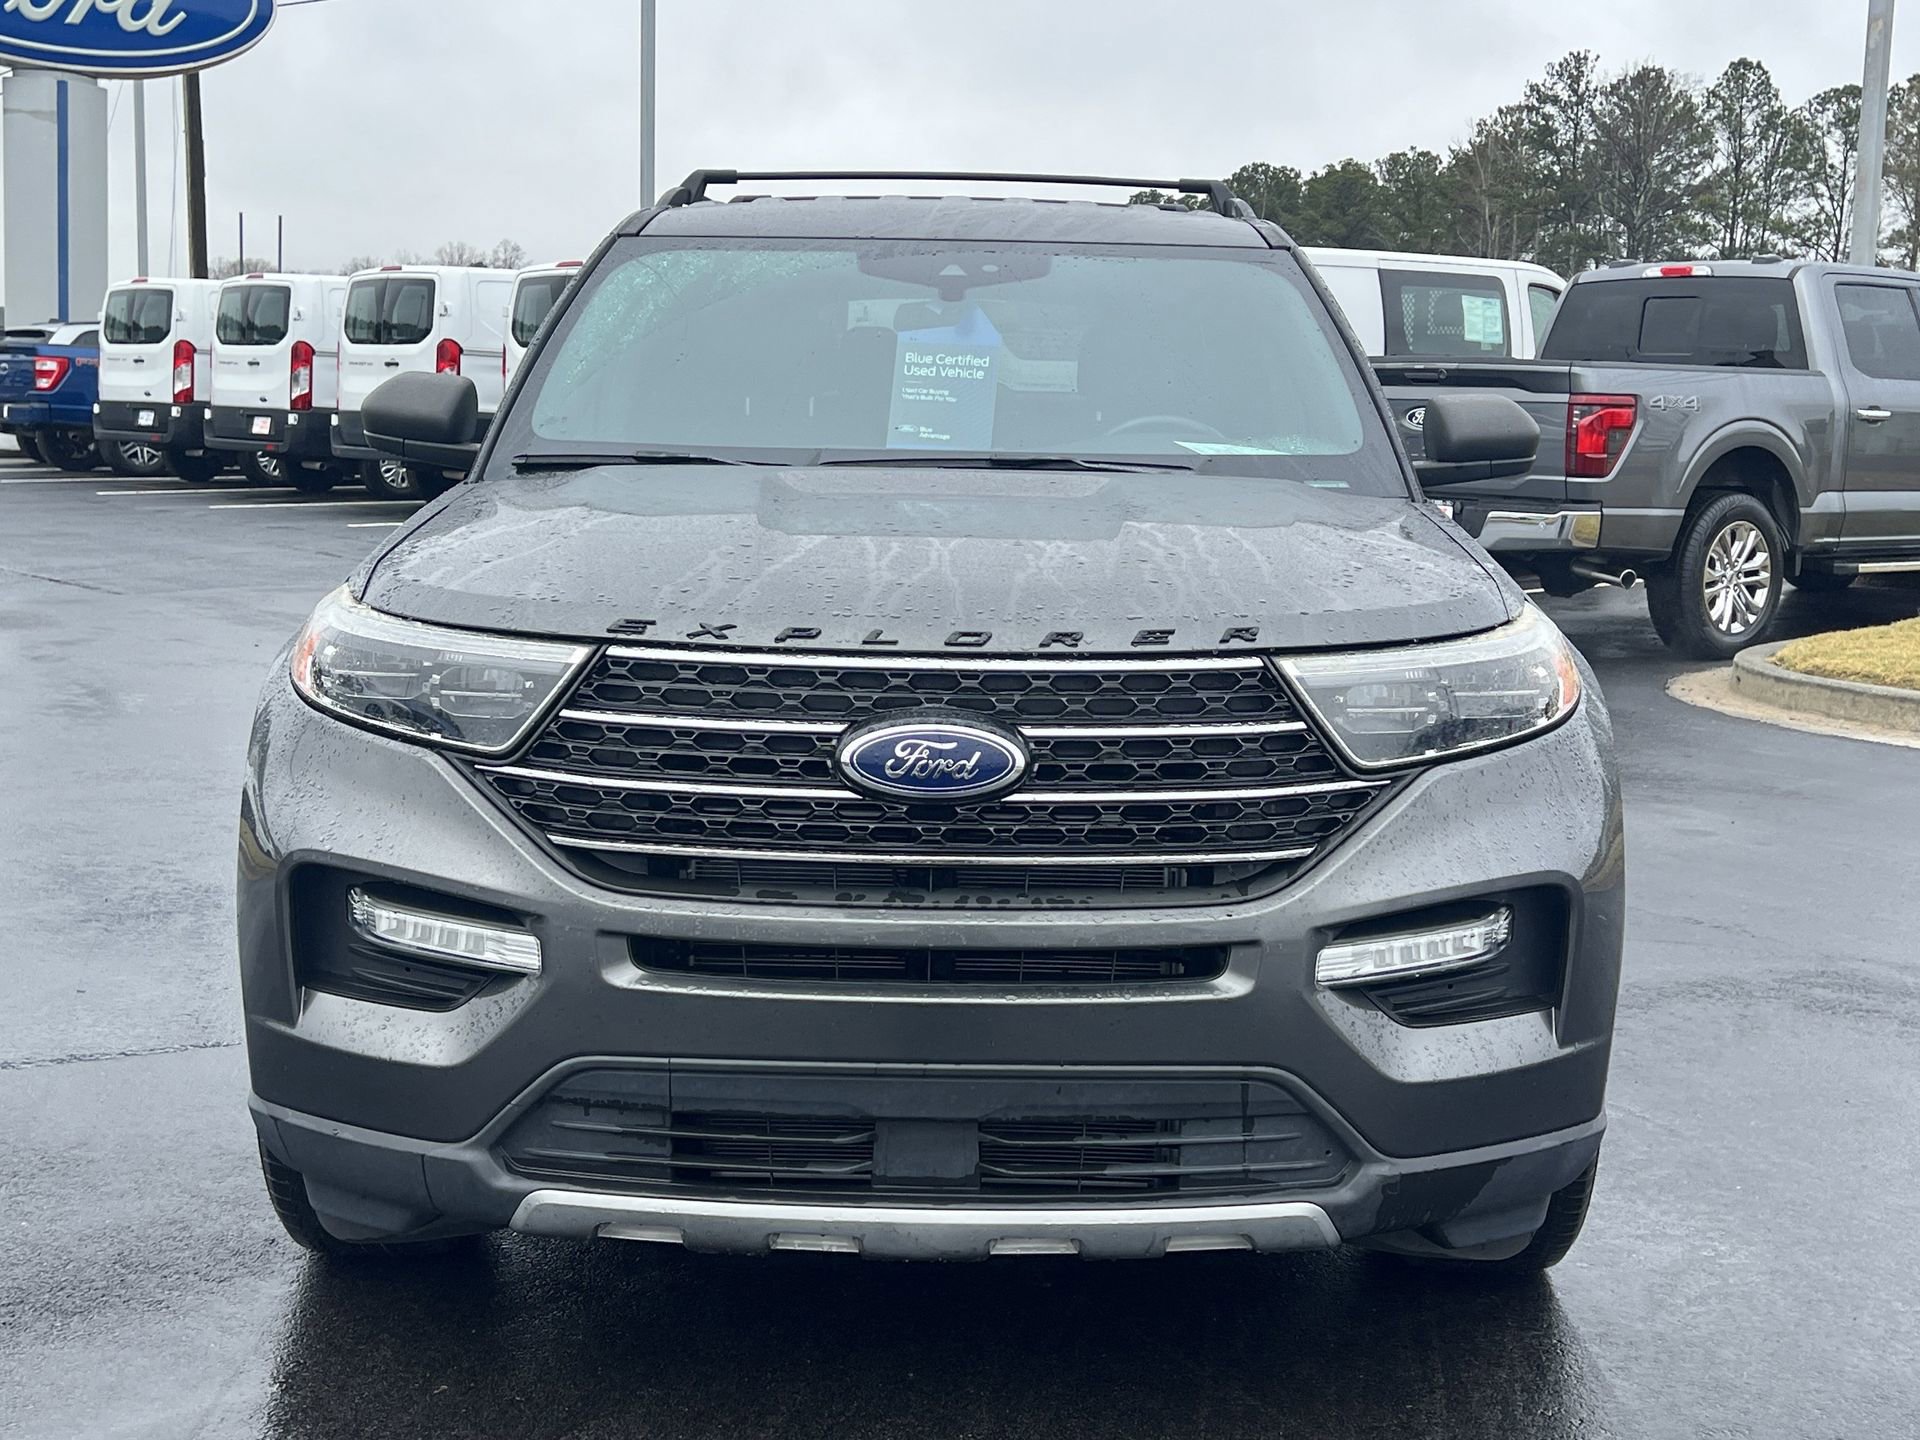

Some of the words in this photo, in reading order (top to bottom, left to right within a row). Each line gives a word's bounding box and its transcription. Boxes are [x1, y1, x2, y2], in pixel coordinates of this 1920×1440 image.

[905, 352, 933, 364] Blue
[936, 354, 989, 367] Certified
[904, 365, 936, 376] Used
[940, 366, 984, 379] Vehicle
[606, 619, 1260, 648] EXPLORER
[885, 739, 981, 780] Ford
